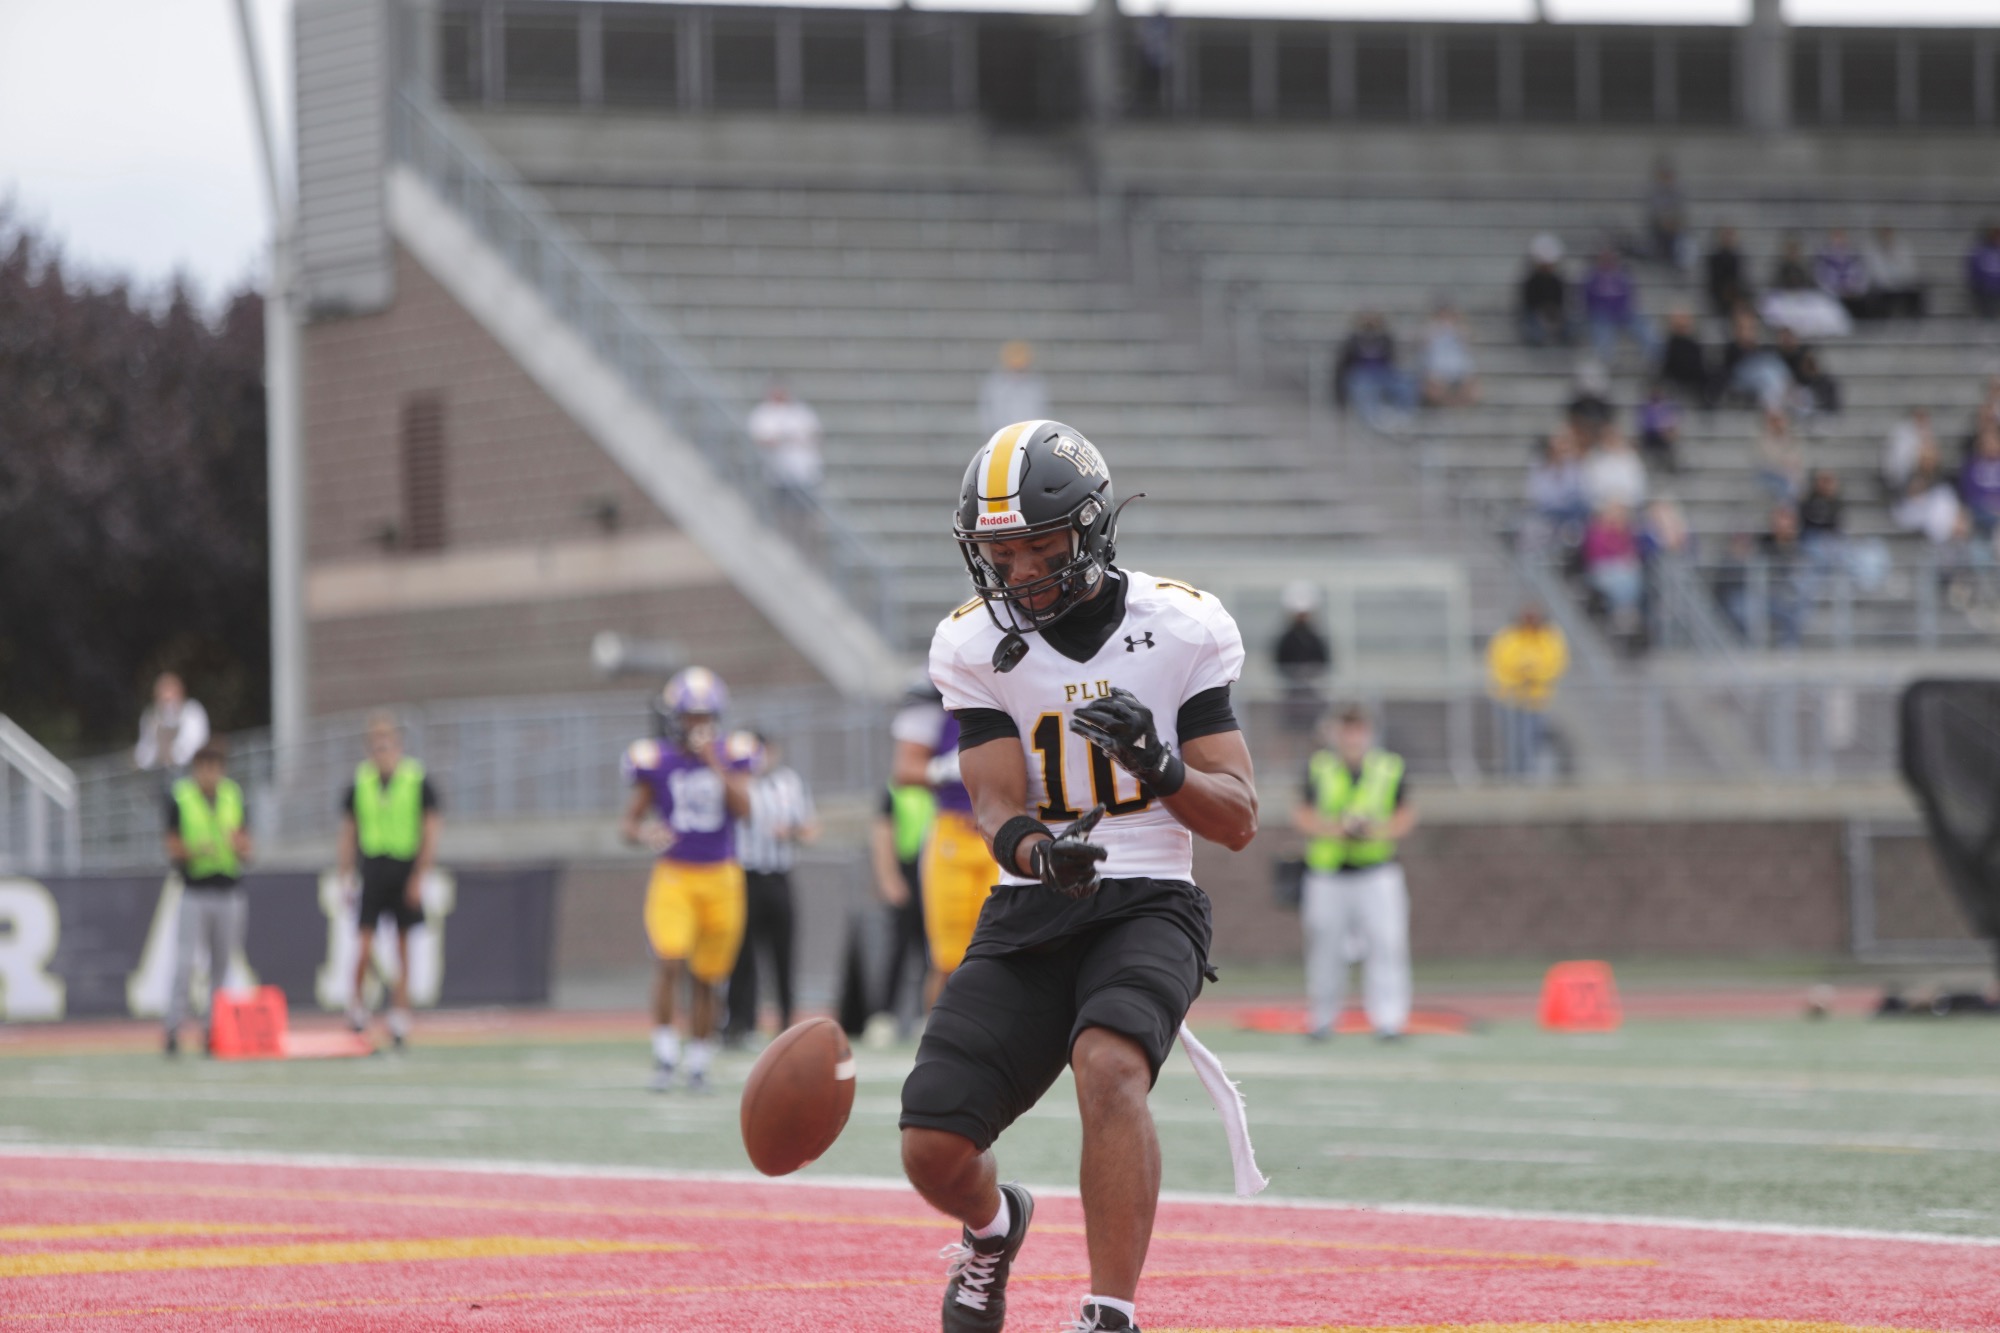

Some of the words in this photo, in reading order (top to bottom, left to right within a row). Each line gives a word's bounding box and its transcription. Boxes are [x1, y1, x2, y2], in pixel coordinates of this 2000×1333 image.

[980, 513, 1017, 526] Riddell
[974, 554, 1001, 585] Riddell
[1064, 680, 1111, 702] PLU
